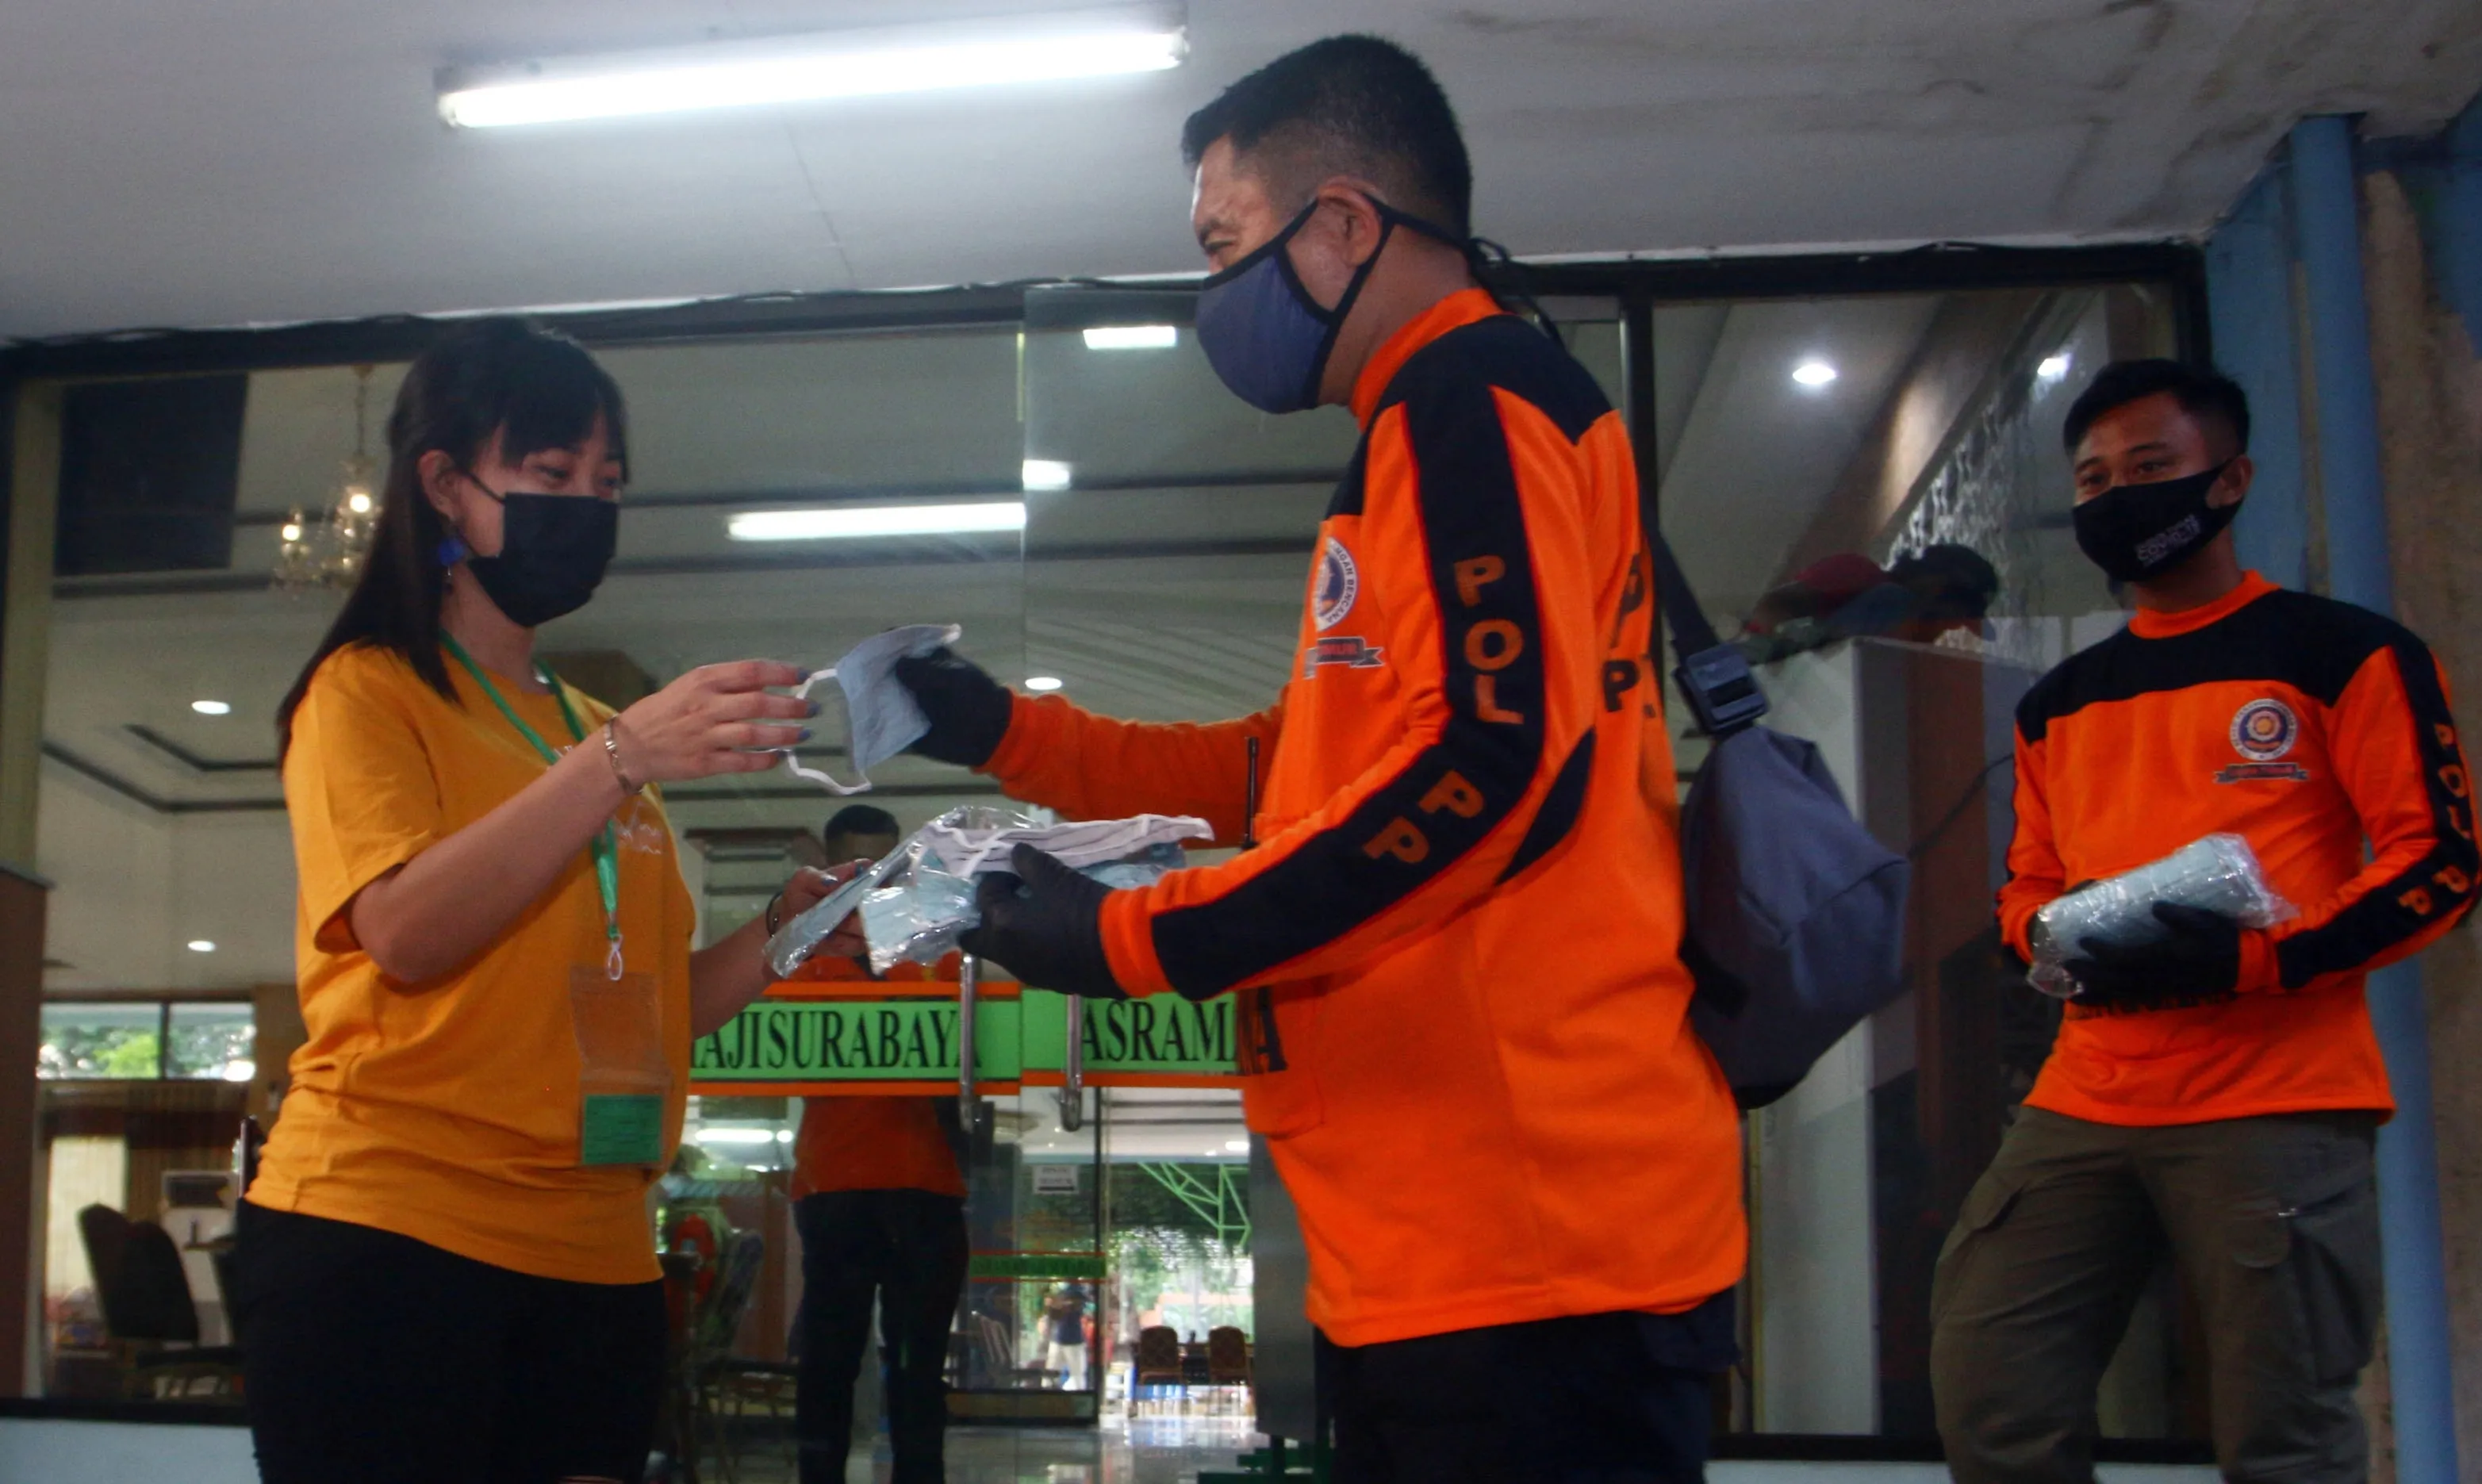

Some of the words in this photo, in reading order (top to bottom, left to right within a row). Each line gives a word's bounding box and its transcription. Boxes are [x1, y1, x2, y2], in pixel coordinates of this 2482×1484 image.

[1454, 554, 1525, 725] POL
[1362, 769, 1486, 864] PP
[2397, 864, 2471, 915] PP
[690, 1010, 982, 1069] AJISURABAY
[1081, 999, 1237, 1062] ASRAM
